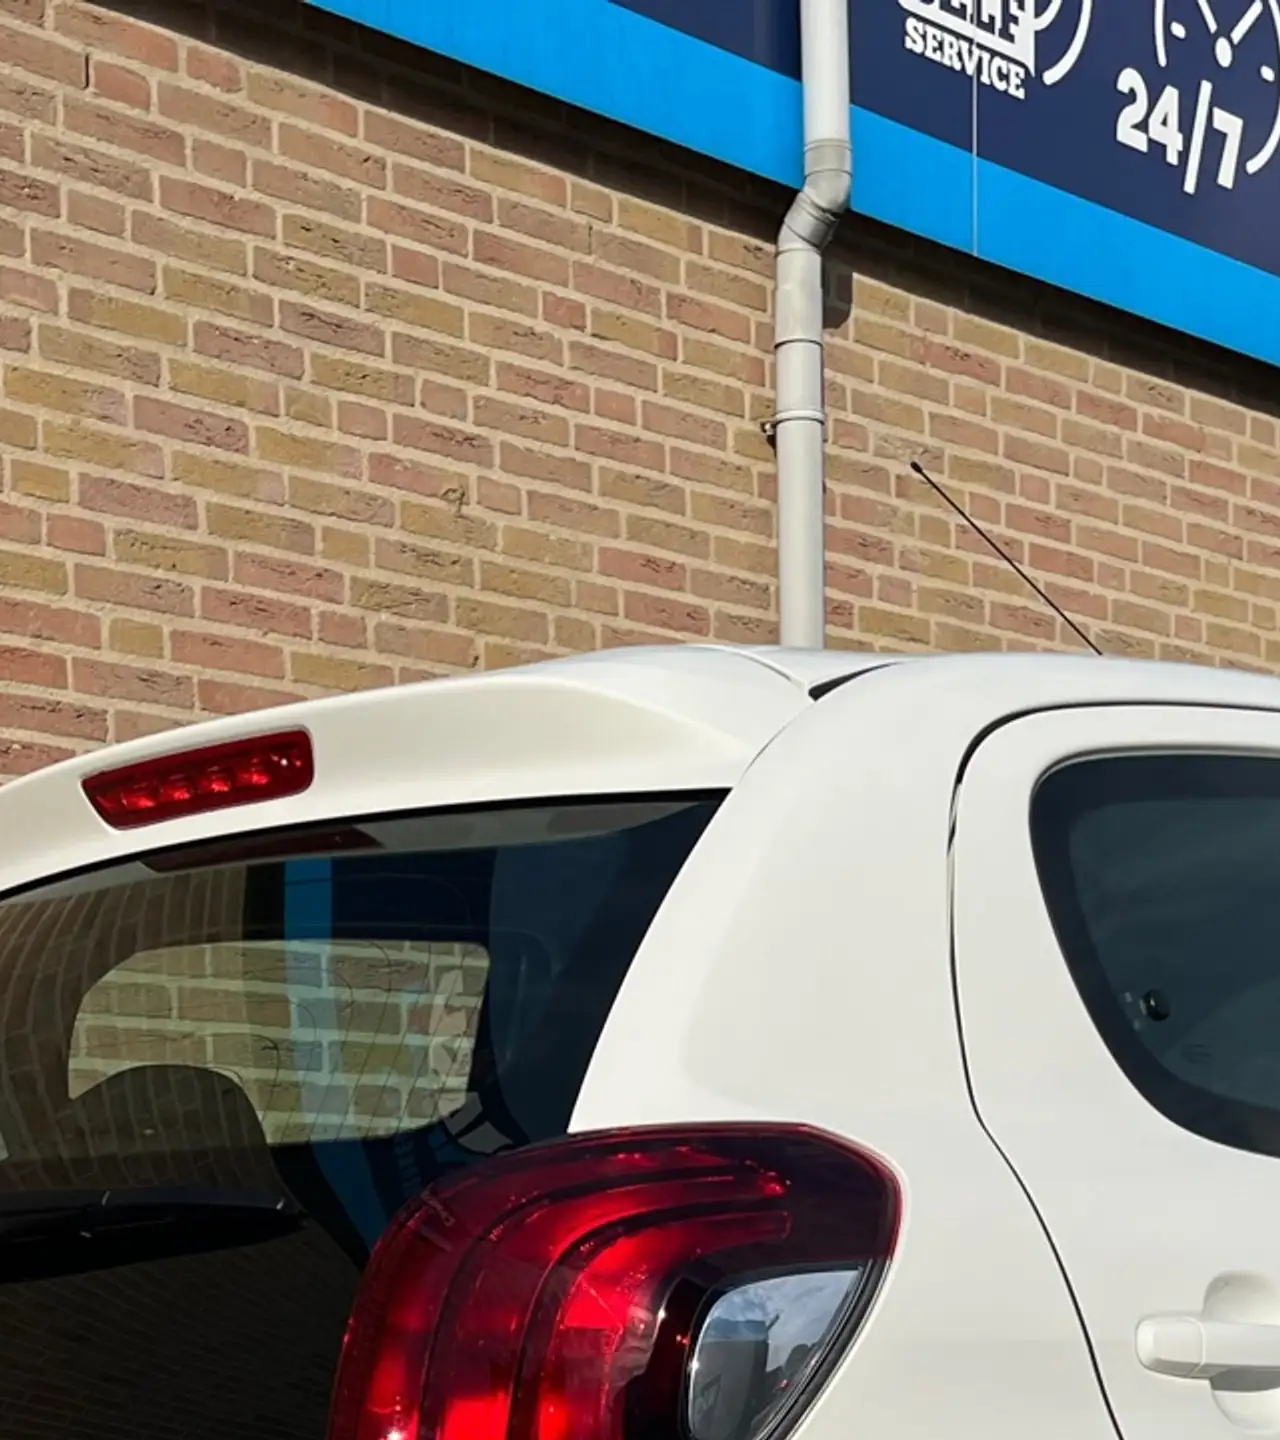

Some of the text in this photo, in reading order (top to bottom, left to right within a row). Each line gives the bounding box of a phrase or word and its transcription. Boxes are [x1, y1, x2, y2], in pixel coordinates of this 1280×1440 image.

[904, 16, 1026, 100] SERVICE
[919, 0, 1025, 44] LF
[1116, 66, 1244, 196] 24/7
